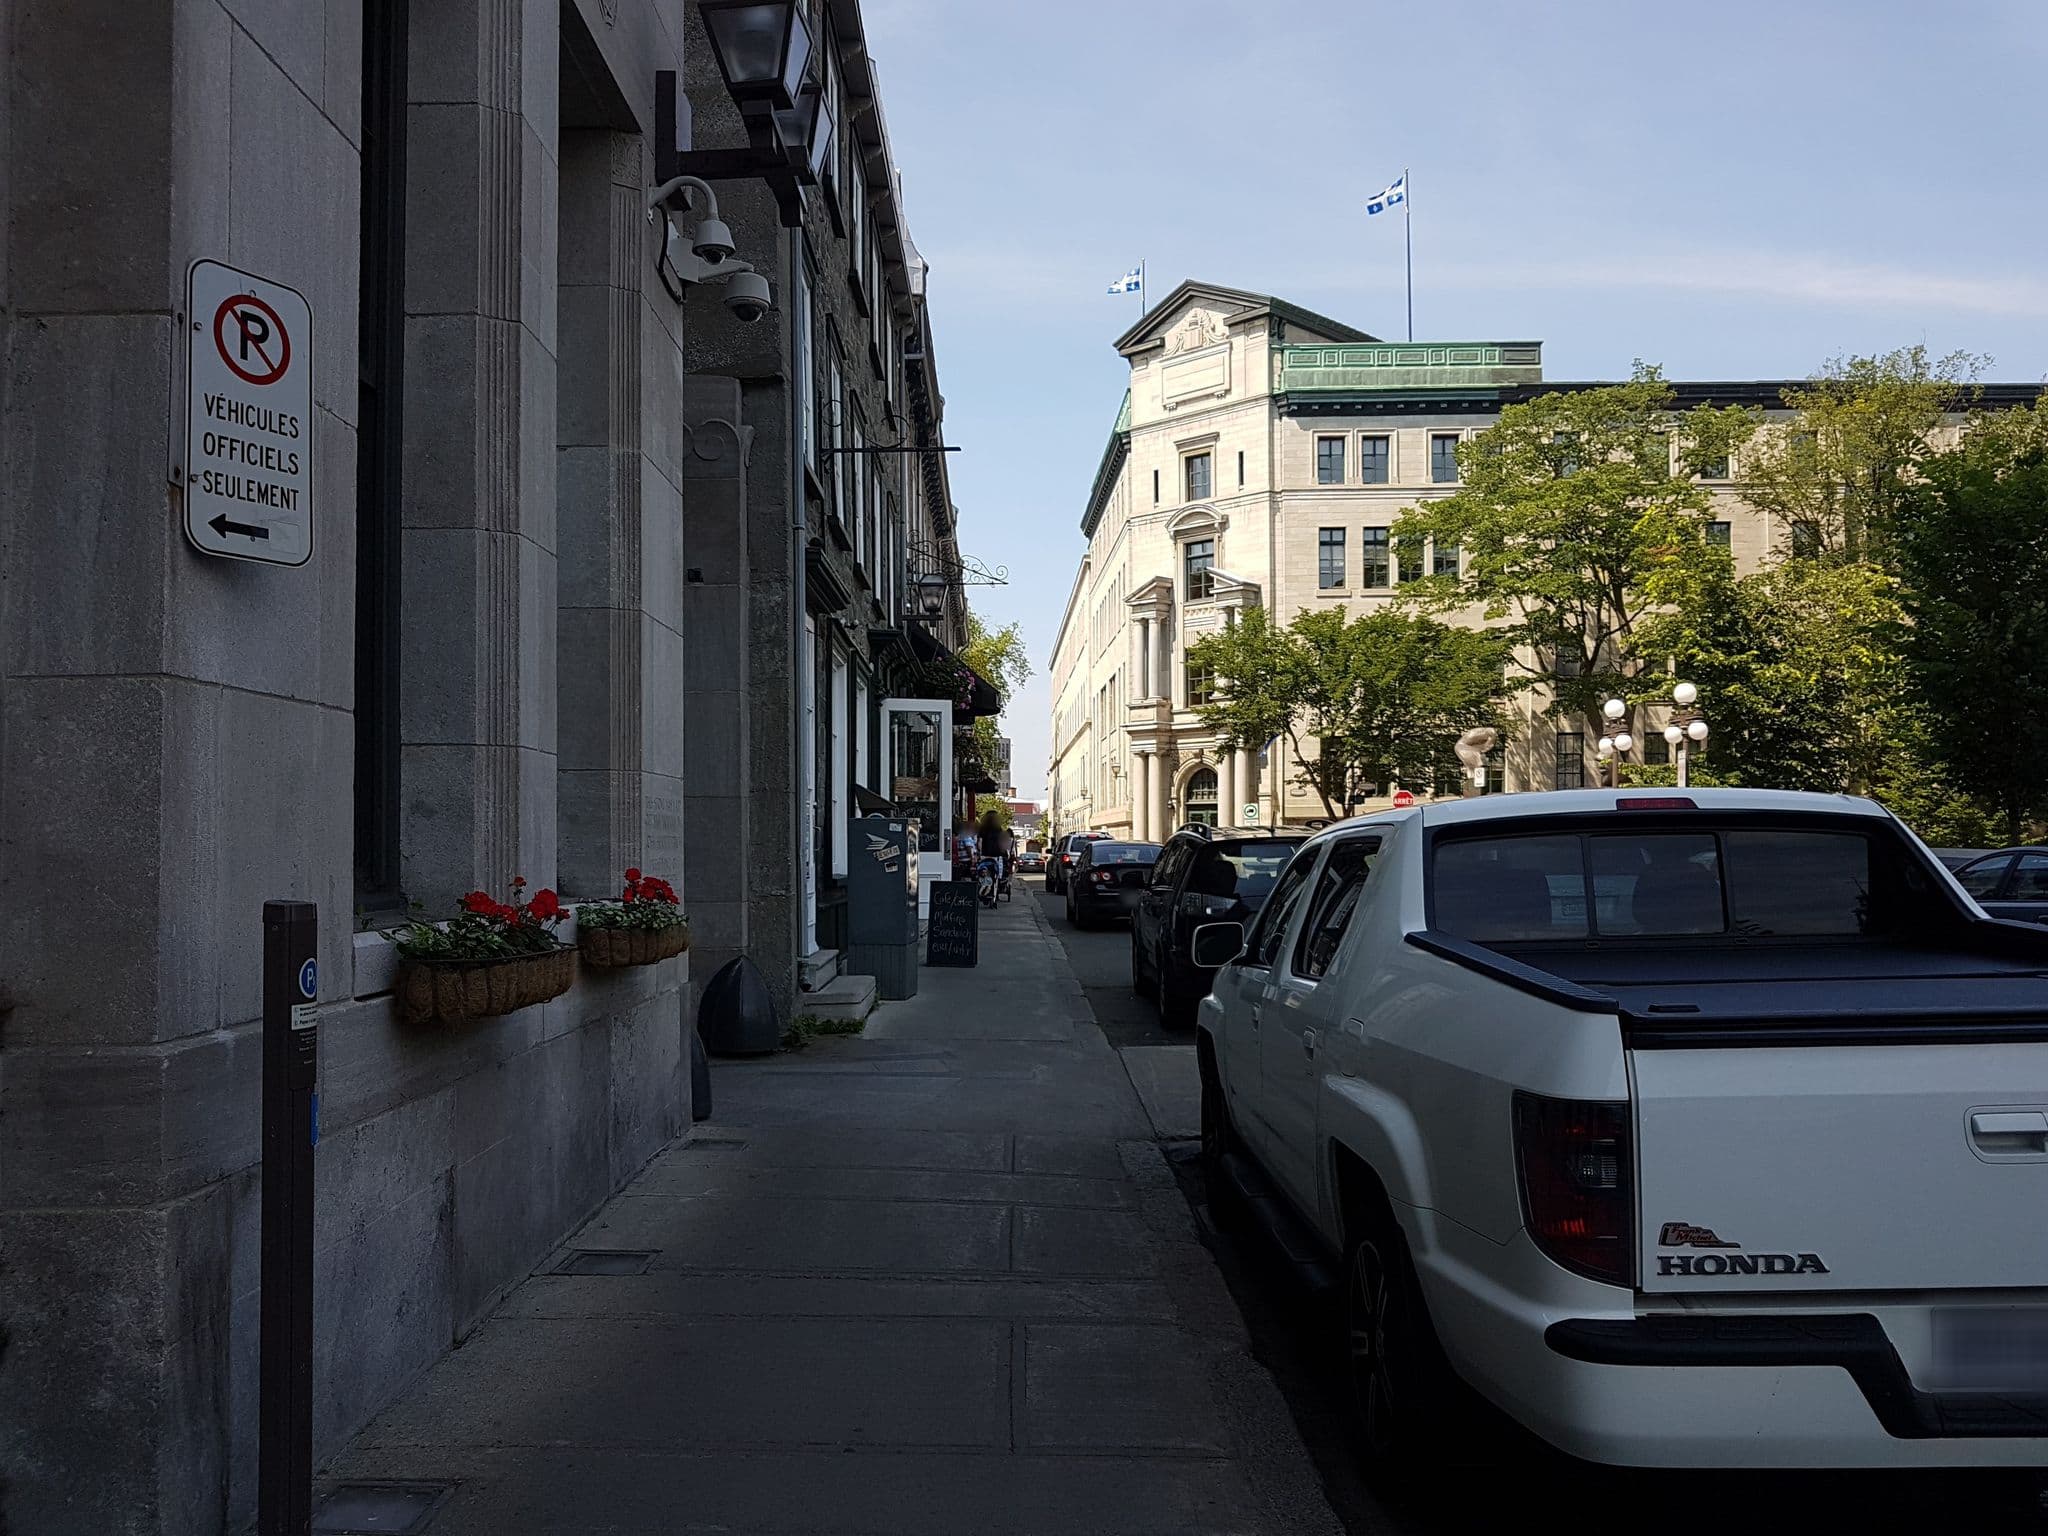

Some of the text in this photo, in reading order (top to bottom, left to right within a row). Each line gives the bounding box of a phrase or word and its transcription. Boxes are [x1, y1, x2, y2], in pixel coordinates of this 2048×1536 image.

[240, 309, 270, 361] P
[204, 391, 299, 439] VÉHICULES
[203, 431, 299, 476] OFFICIELS
[202, 470, 299, 512] SEULEMENT
[1393, 796, 1414, 805] ARRÊT
[1656, 1253, 1831, 1276] HONDA
